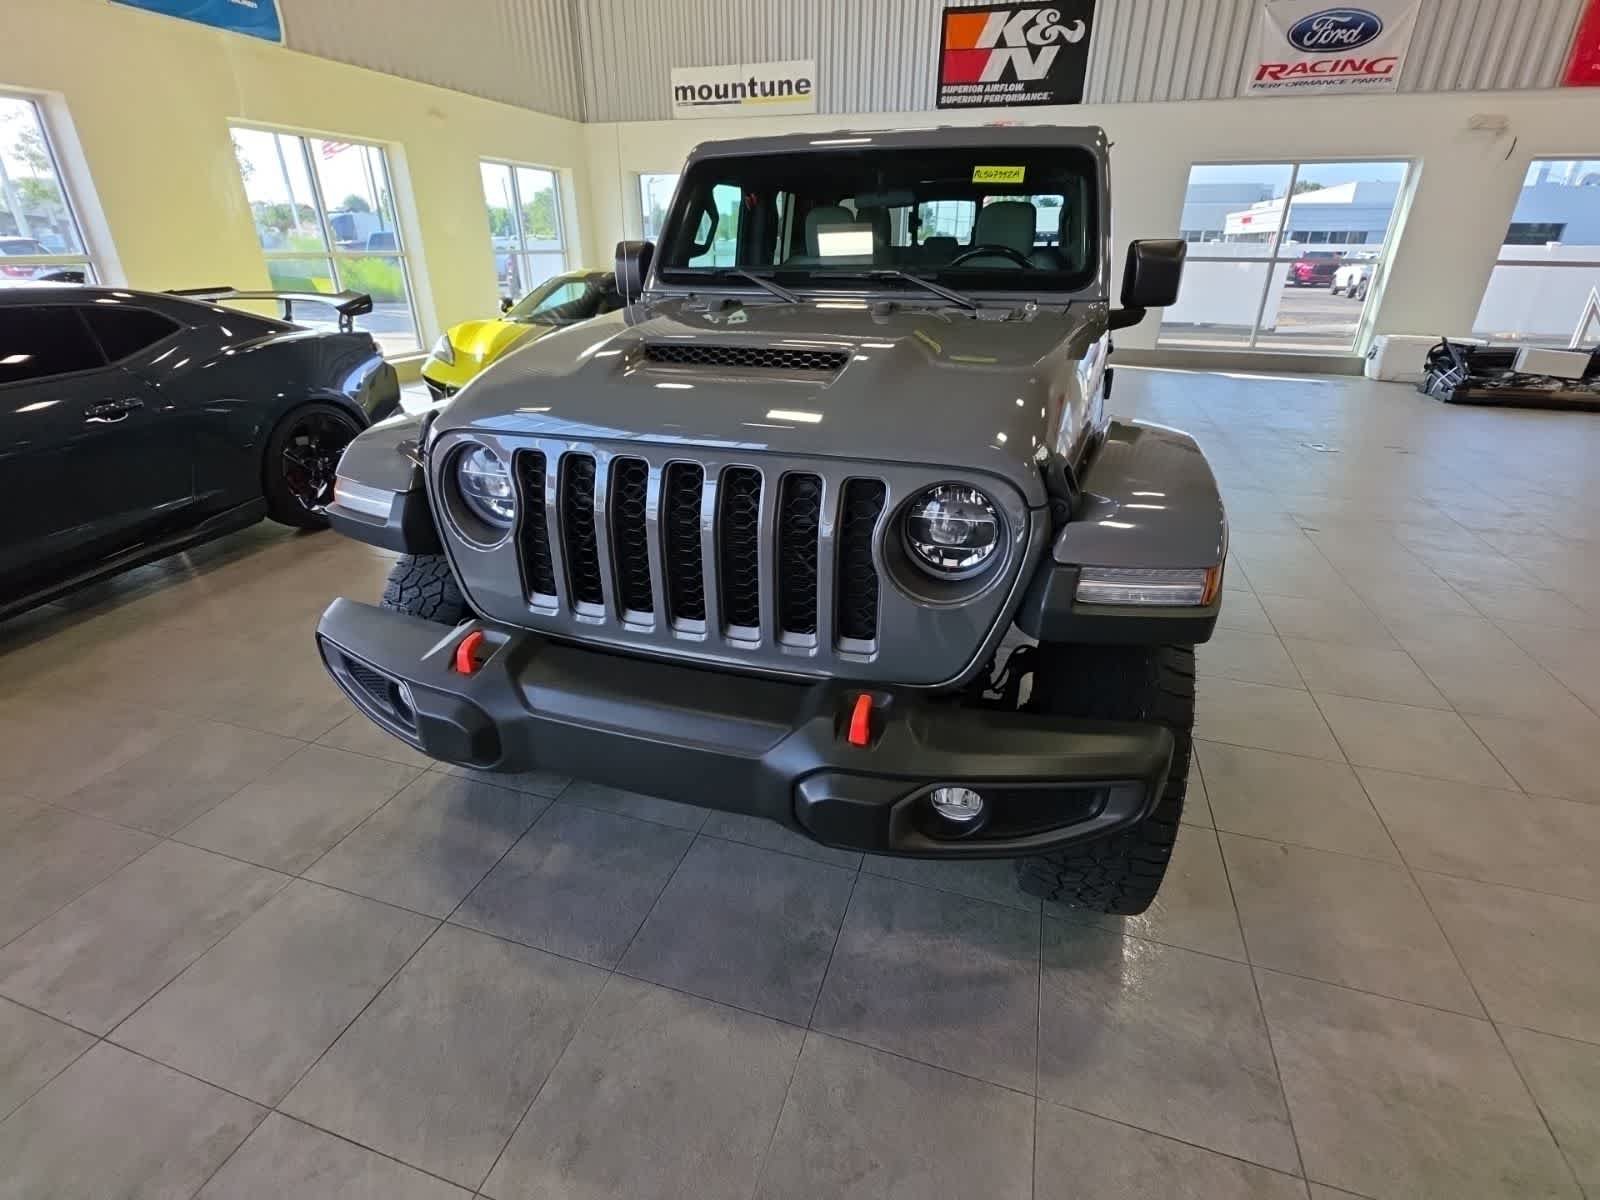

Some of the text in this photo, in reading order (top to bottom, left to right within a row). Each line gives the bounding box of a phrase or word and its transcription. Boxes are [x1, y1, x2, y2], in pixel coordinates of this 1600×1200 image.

[1303, 16, 1365, 46] Ford
[1255, 57, 1398, 80] RACING
[674, 76, 811, 101] mountune
[941, 84, 984, 93] SUPERIOR
[1252, 79, 1346, 89] PERFORMANCE
[940, 94, 983, 104] SUPERIOR
